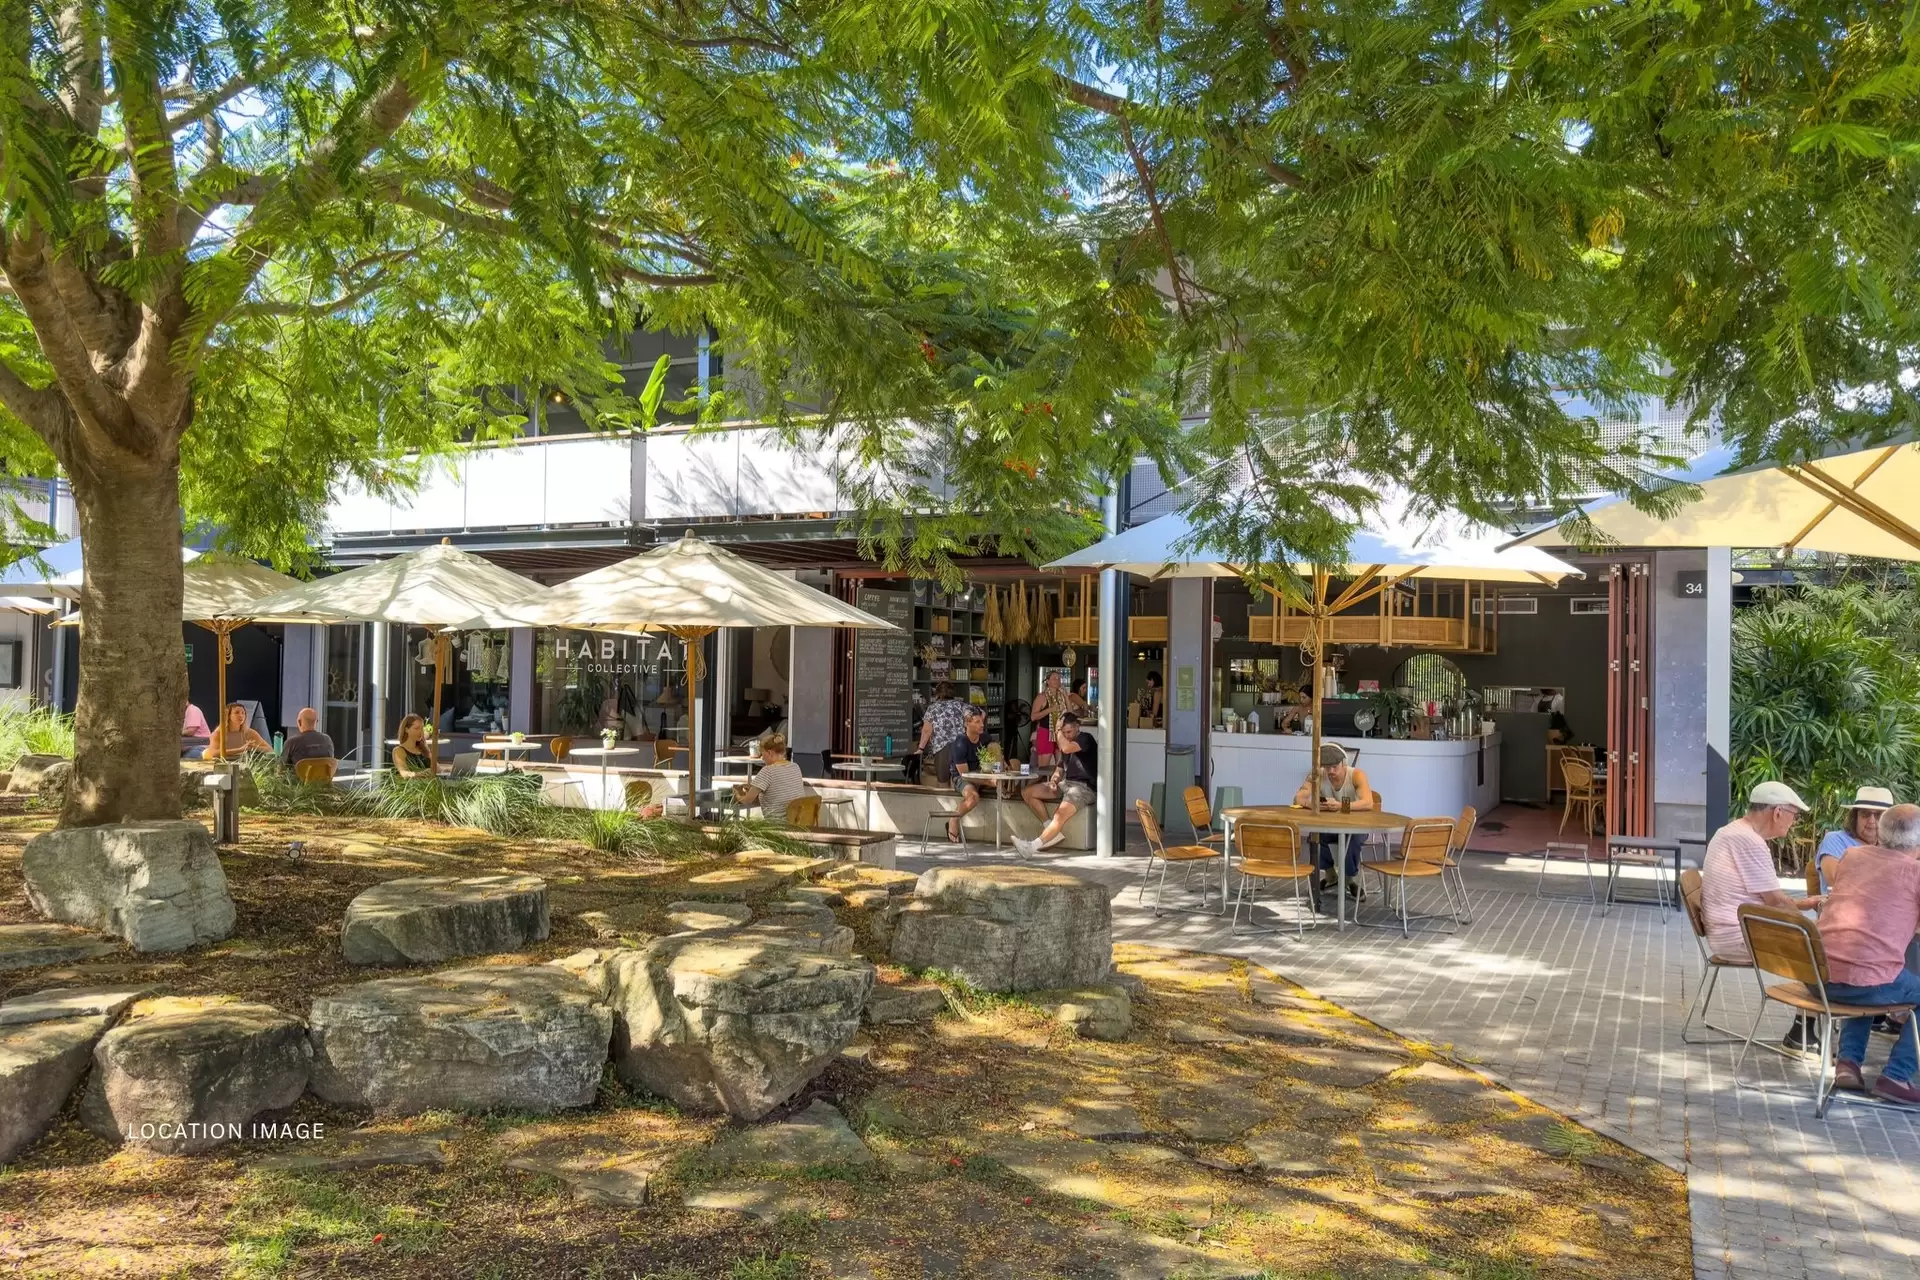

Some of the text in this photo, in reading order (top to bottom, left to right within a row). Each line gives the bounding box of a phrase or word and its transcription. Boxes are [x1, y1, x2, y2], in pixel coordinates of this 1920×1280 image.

[1685, 583, 1703, 594] 34
[556, 638, 688, 660] HABITAT
[587, 663, 657, 674] COLLECTIVE
